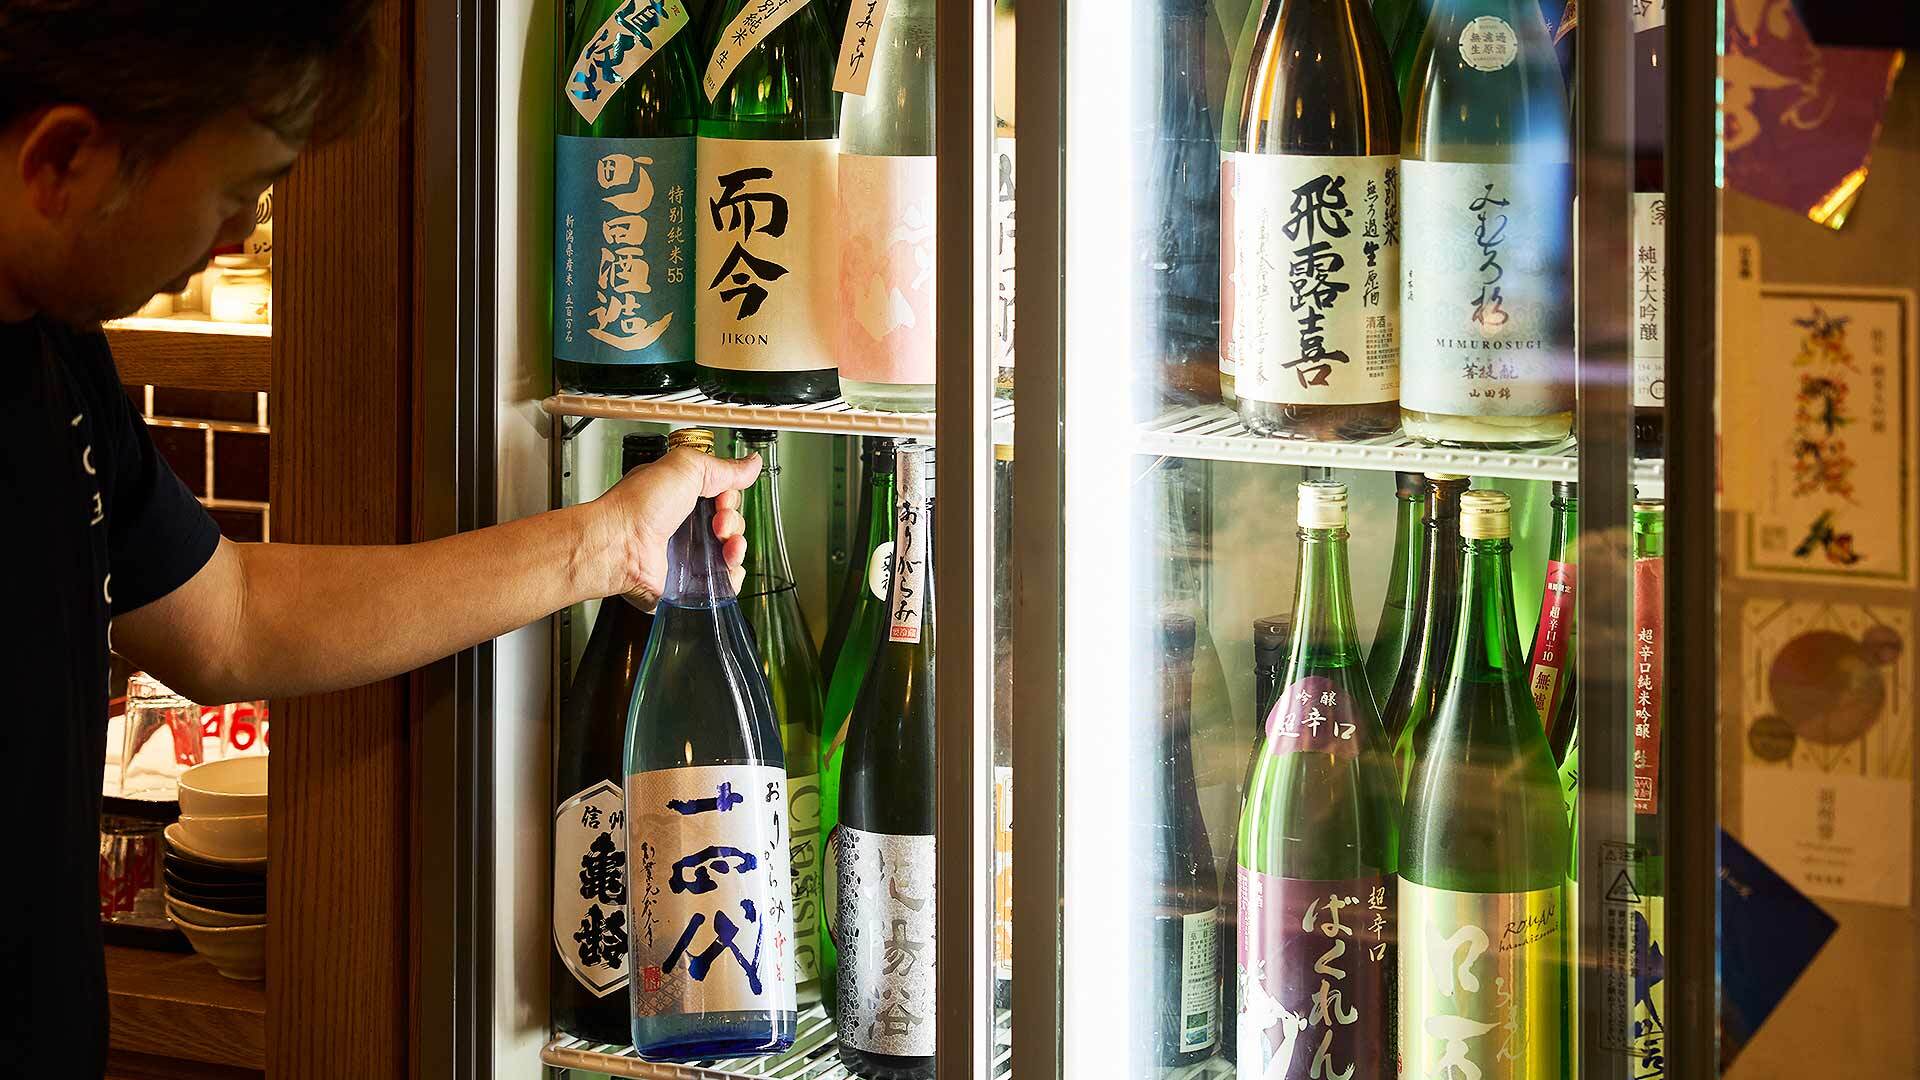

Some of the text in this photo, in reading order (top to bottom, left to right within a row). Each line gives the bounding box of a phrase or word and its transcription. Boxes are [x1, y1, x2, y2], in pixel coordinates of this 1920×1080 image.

[1471, 44, 1506, 55] 生原酒
[587, 153, 674, 351] 町田酒造
[666, 186, 684, 284] 特別純米55
[708, 167, 791, 320] 而今
[1282, 175, 1353, 389] 飛露喜
[1366, 315, 1385, 328] 清酒
[1638, 246, 1658, 342] 純米大吟醸
[721, 333, 768, 347] JIKON
[1436, 338, 1542, 350] MIMUROSUGI
[1469, 388, 1511, 400] 山田錦
[894, 500, 922, 623] おりがらみ
[1279, 707, 1357, 740] 超辛口
[1297, 689, 1337, 707] 吟醸
[1635, 628, 1654, 739] 超辛口純米吟醸
[581, 806, 625, 830] 信州
[662, 781, 764, 996] 十四代
[1367, 886, 1388, 962] 超辛口
[1302, 894, 1360, 1080] ばくれん
